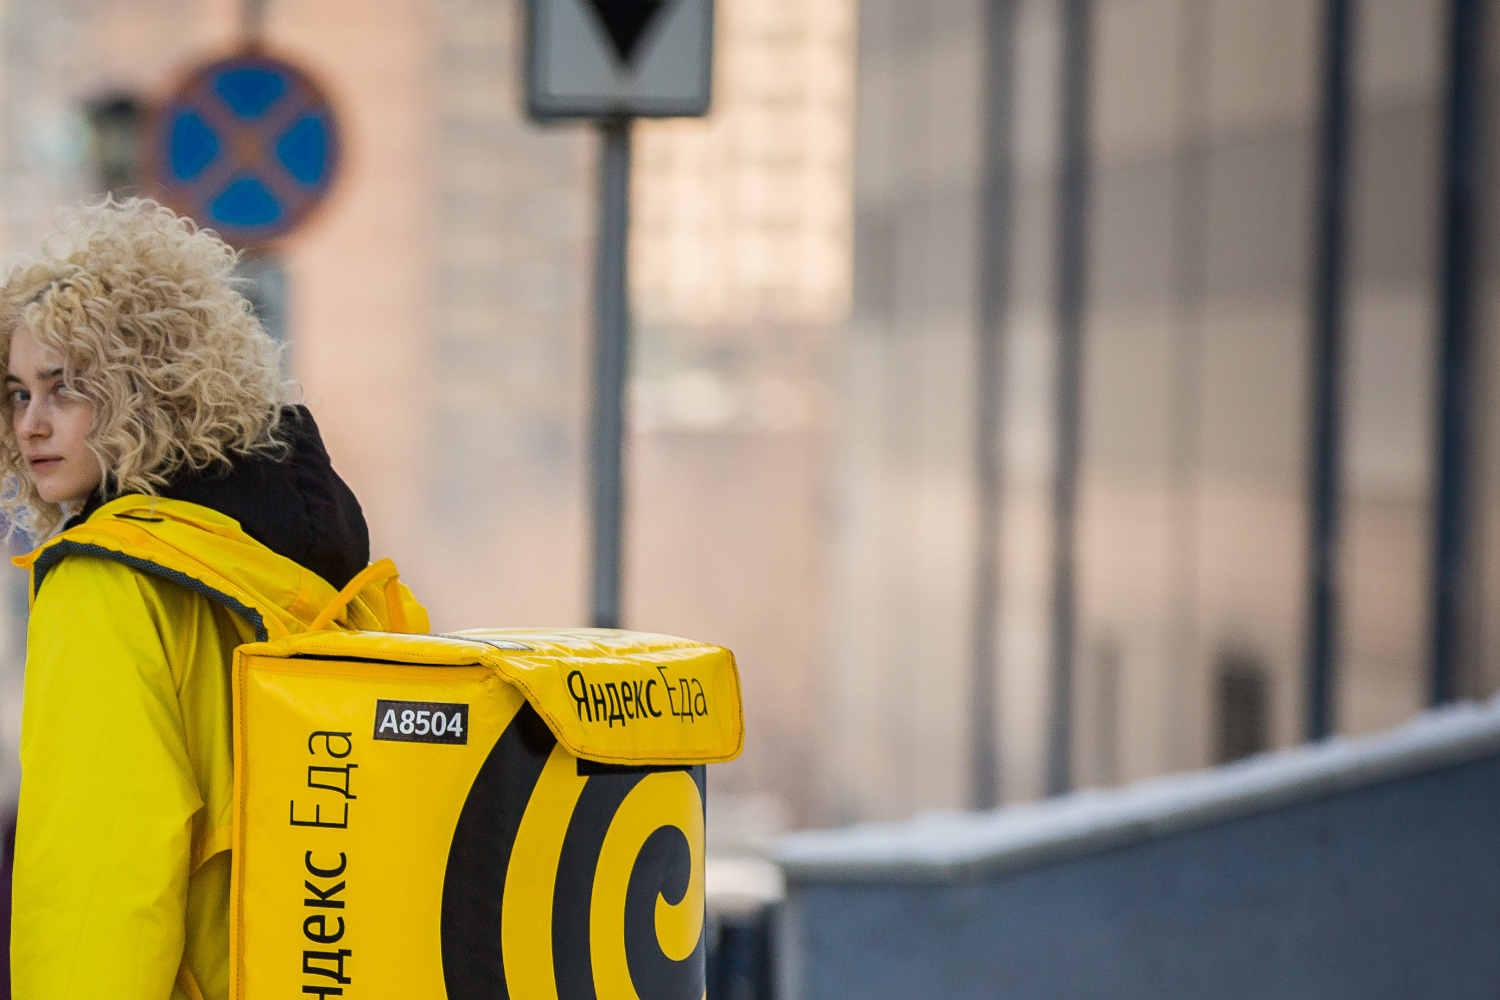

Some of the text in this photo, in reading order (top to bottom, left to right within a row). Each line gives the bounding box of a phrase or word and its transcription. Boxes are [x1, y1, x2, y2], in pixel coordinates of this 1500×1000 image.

[379, 708, 463, 737] A8504
[567, 666, 708, 727] Яндекс Еда
[290, 730, 359, 829] Еда
